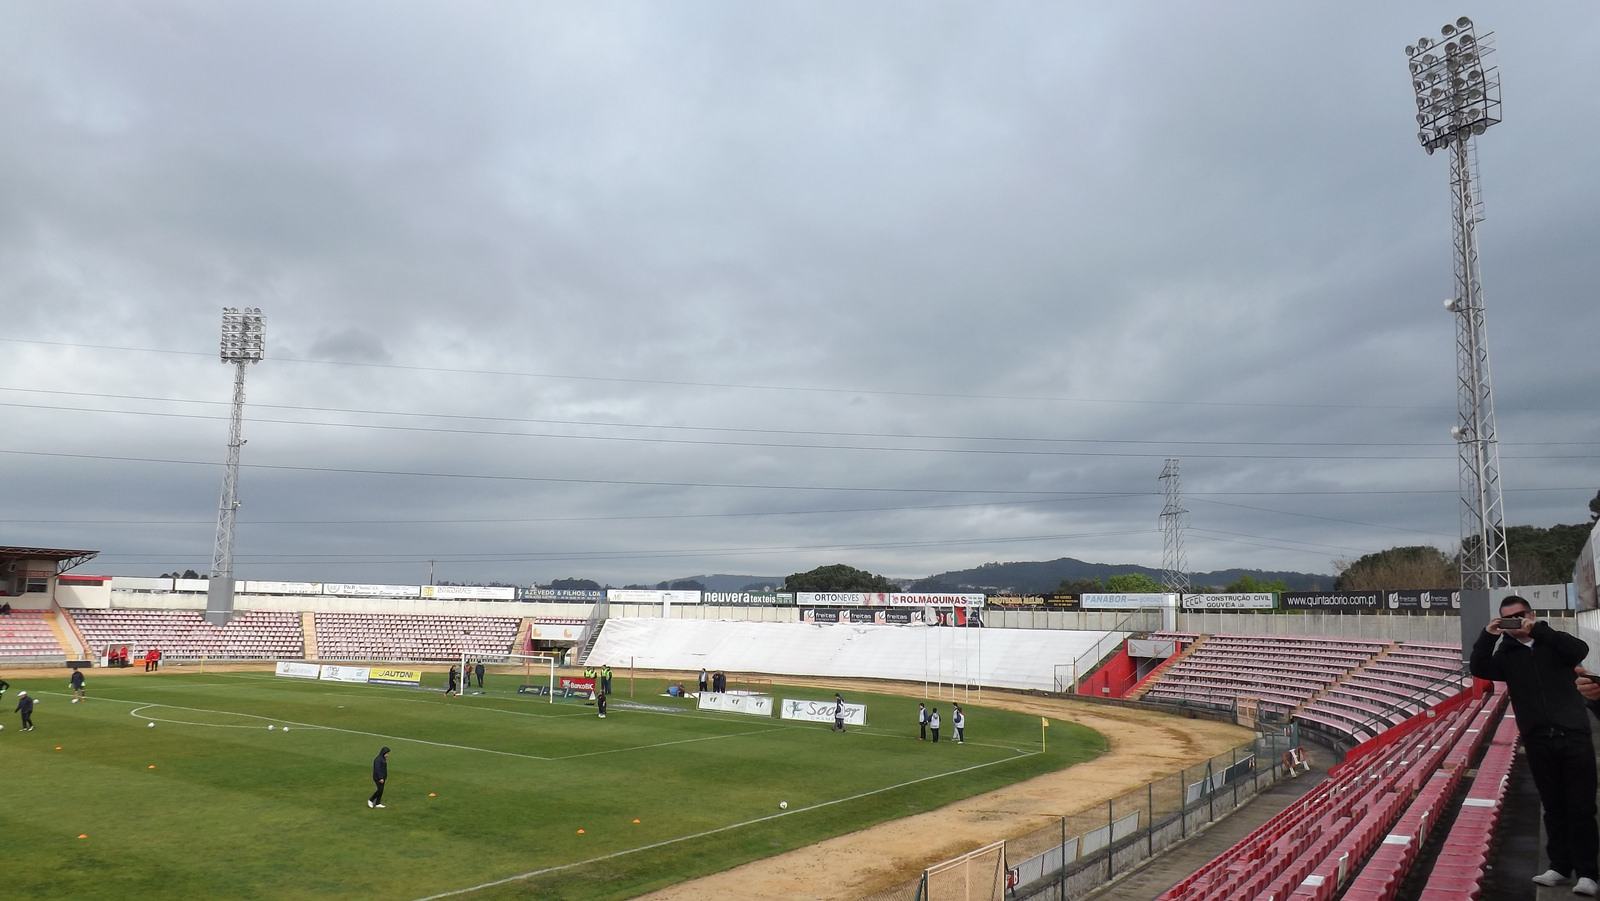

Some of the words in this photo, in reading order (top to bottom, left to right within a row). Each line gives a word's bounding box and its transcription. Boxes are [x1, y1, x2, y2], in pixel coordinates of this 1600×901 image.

[705, 592, 750, 603] neuvera
[750, 595, 776, 604] texteis
[814, 593, 860, 602] ORTONEVES
[1085, 595, 1127, 603] PANABOR
[1287, 594, 1377, 607] www.quintadorio.com.pt
